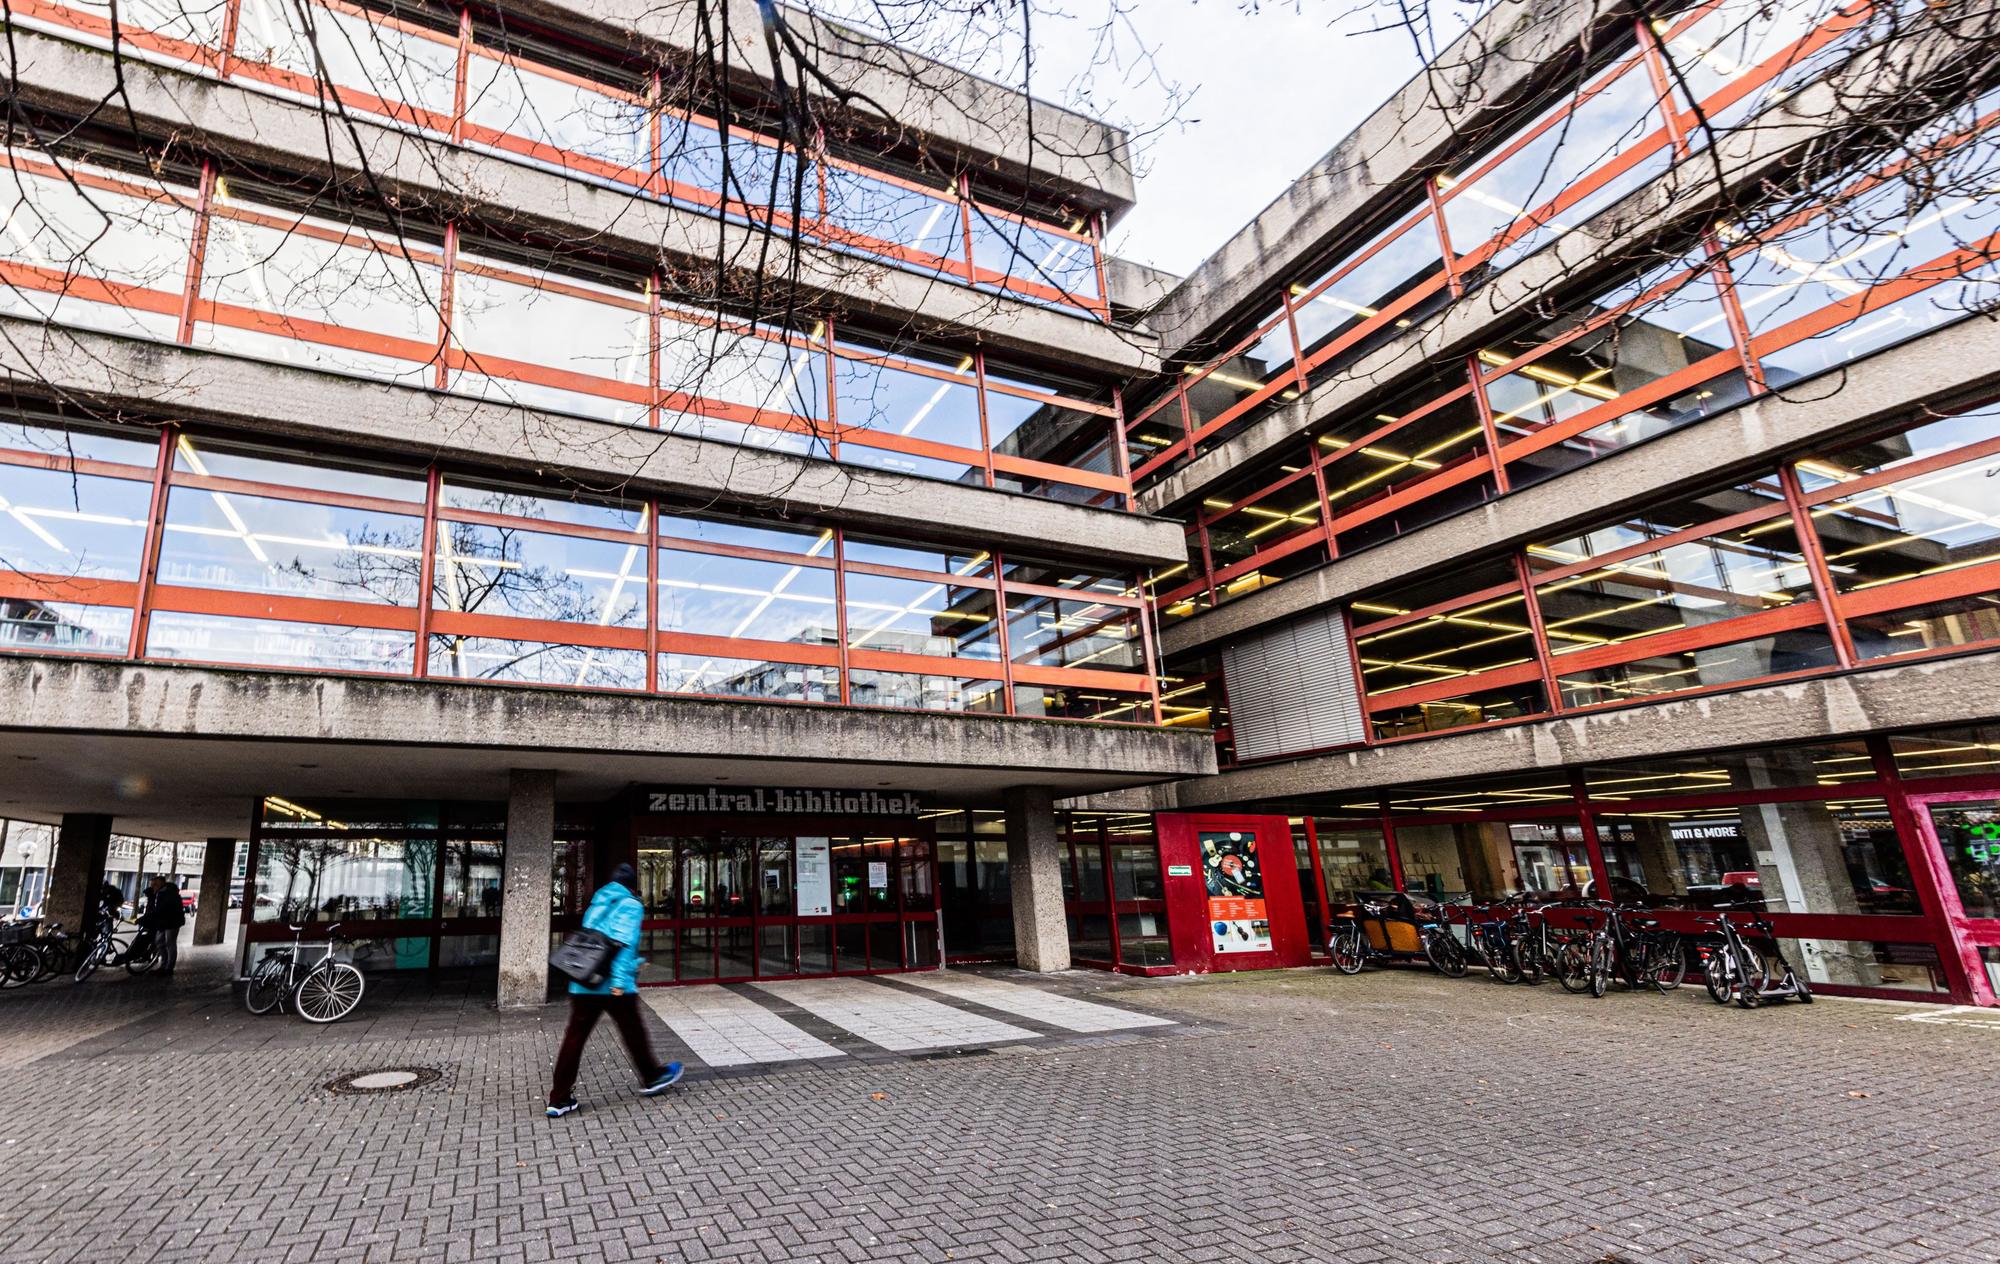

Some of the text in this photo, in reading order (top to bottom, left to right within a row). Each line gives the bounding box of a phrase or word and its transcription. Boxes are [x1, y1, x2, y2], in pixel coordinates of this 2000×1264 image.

[649, 787, 921, 815] zentral-bibliothek
[1693, 828, 1704, 838] &
[1703, 826, 1738, 838] MORE
